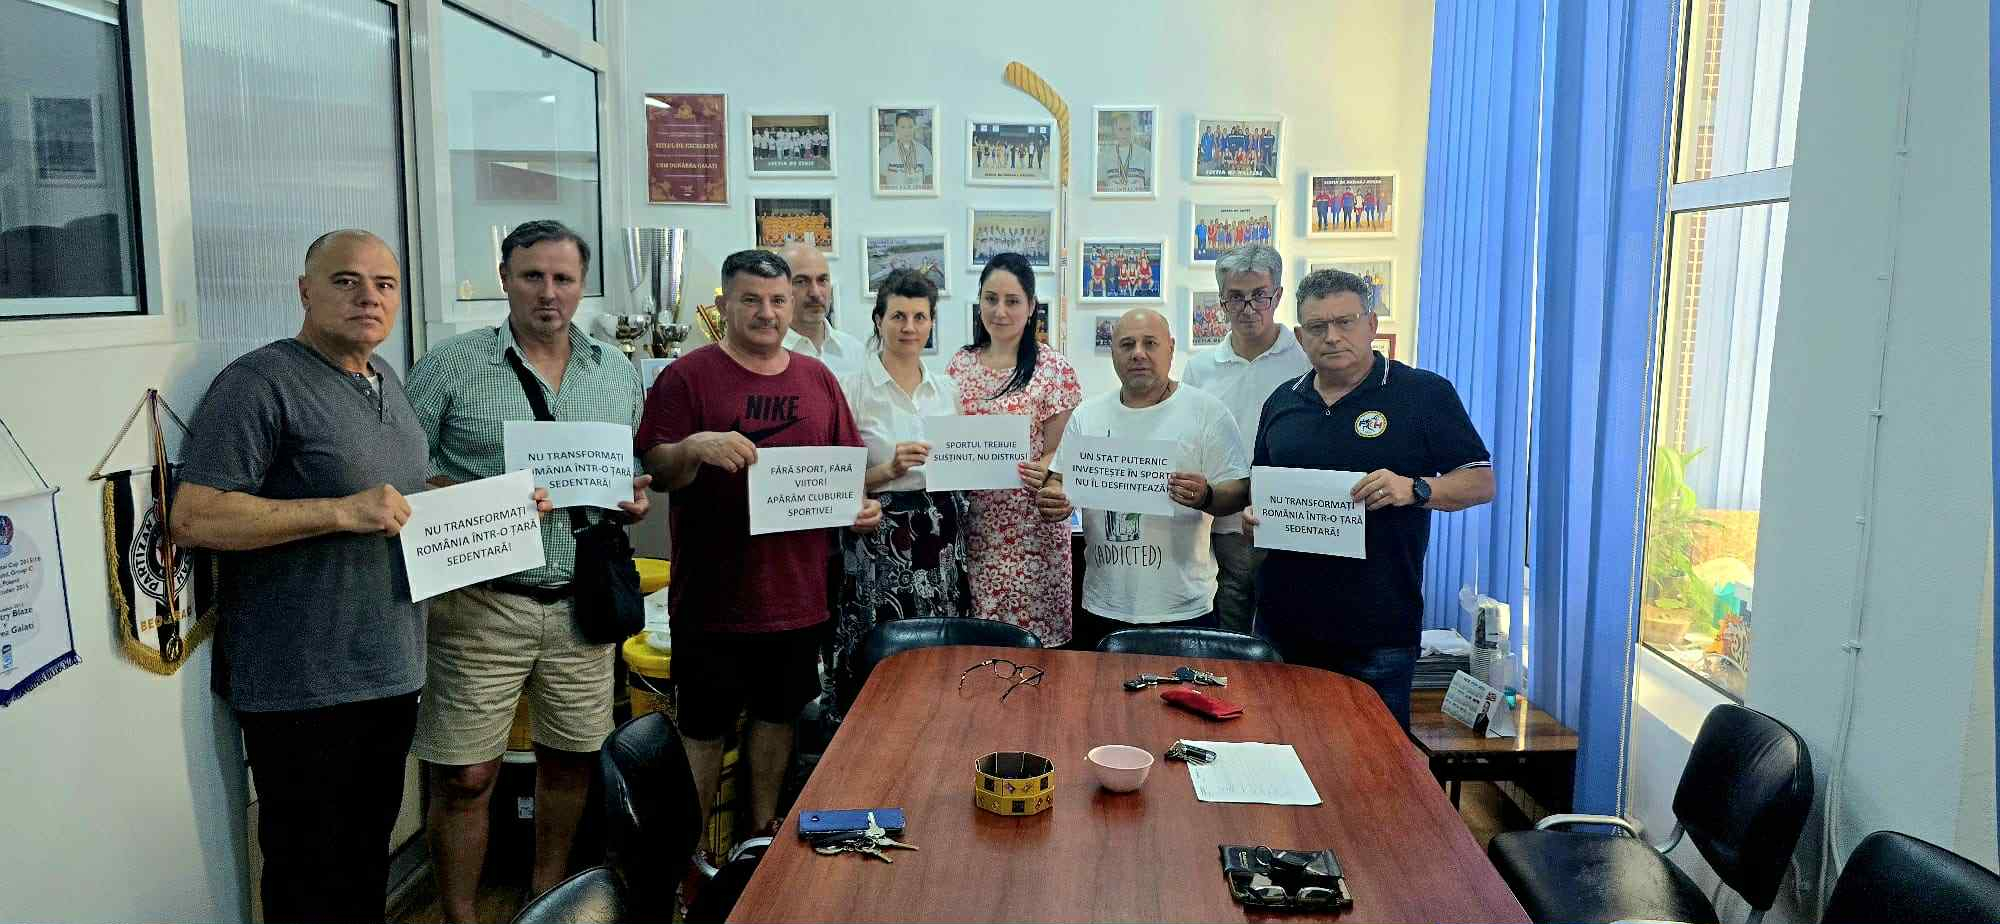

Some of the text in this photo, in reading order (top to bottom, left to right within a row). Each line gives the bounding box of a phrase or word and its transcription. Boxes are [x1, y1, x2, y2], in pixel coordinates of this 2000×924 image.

[745, 395, 800, 421] NIKE
[945, 441, 1017, 449] SPORTUL TREBUIE
[528, 453, 544, 461] NU
[977, 453, 990, 461] NU
[991, 453, 1028, 461] DISTRUS!
[1080, 451, 1168, 466] UN STAT PUTERNIC
[770, 463, 853, 475] FĂRĂ SPORT, FĂRĂ
[1127, 467, 1138, 478] ÎN
[795, 478, 828, 488] VIITOR!
[1075, 478, 1089, 487] NU
[1091, 477, 1099, 488] ÎL
[767, 491, 855, 504] APĂRĂM CLUBURILE
[1270, 495, 1283, 504] NU
[787, 505, 833, 517] SPORTIVE!
[1262, 508, 1305, 520] ROMÂNIA
[1306, 510, 1337, 523] ÎNTR-O
[424, 524, 441, 537] NU
[1285, 525, 1340, 537] SEDENTARĂ!
[416, 537, 470, 557] ROMÂNIA
[472, 527, 508, 543] ÎNTR-O
[136, 520, 159, 591] PARTIZAN
[447, 541, 512, 567] SEDENTARĂ!
[12, 607, 32, 617] Blaze
